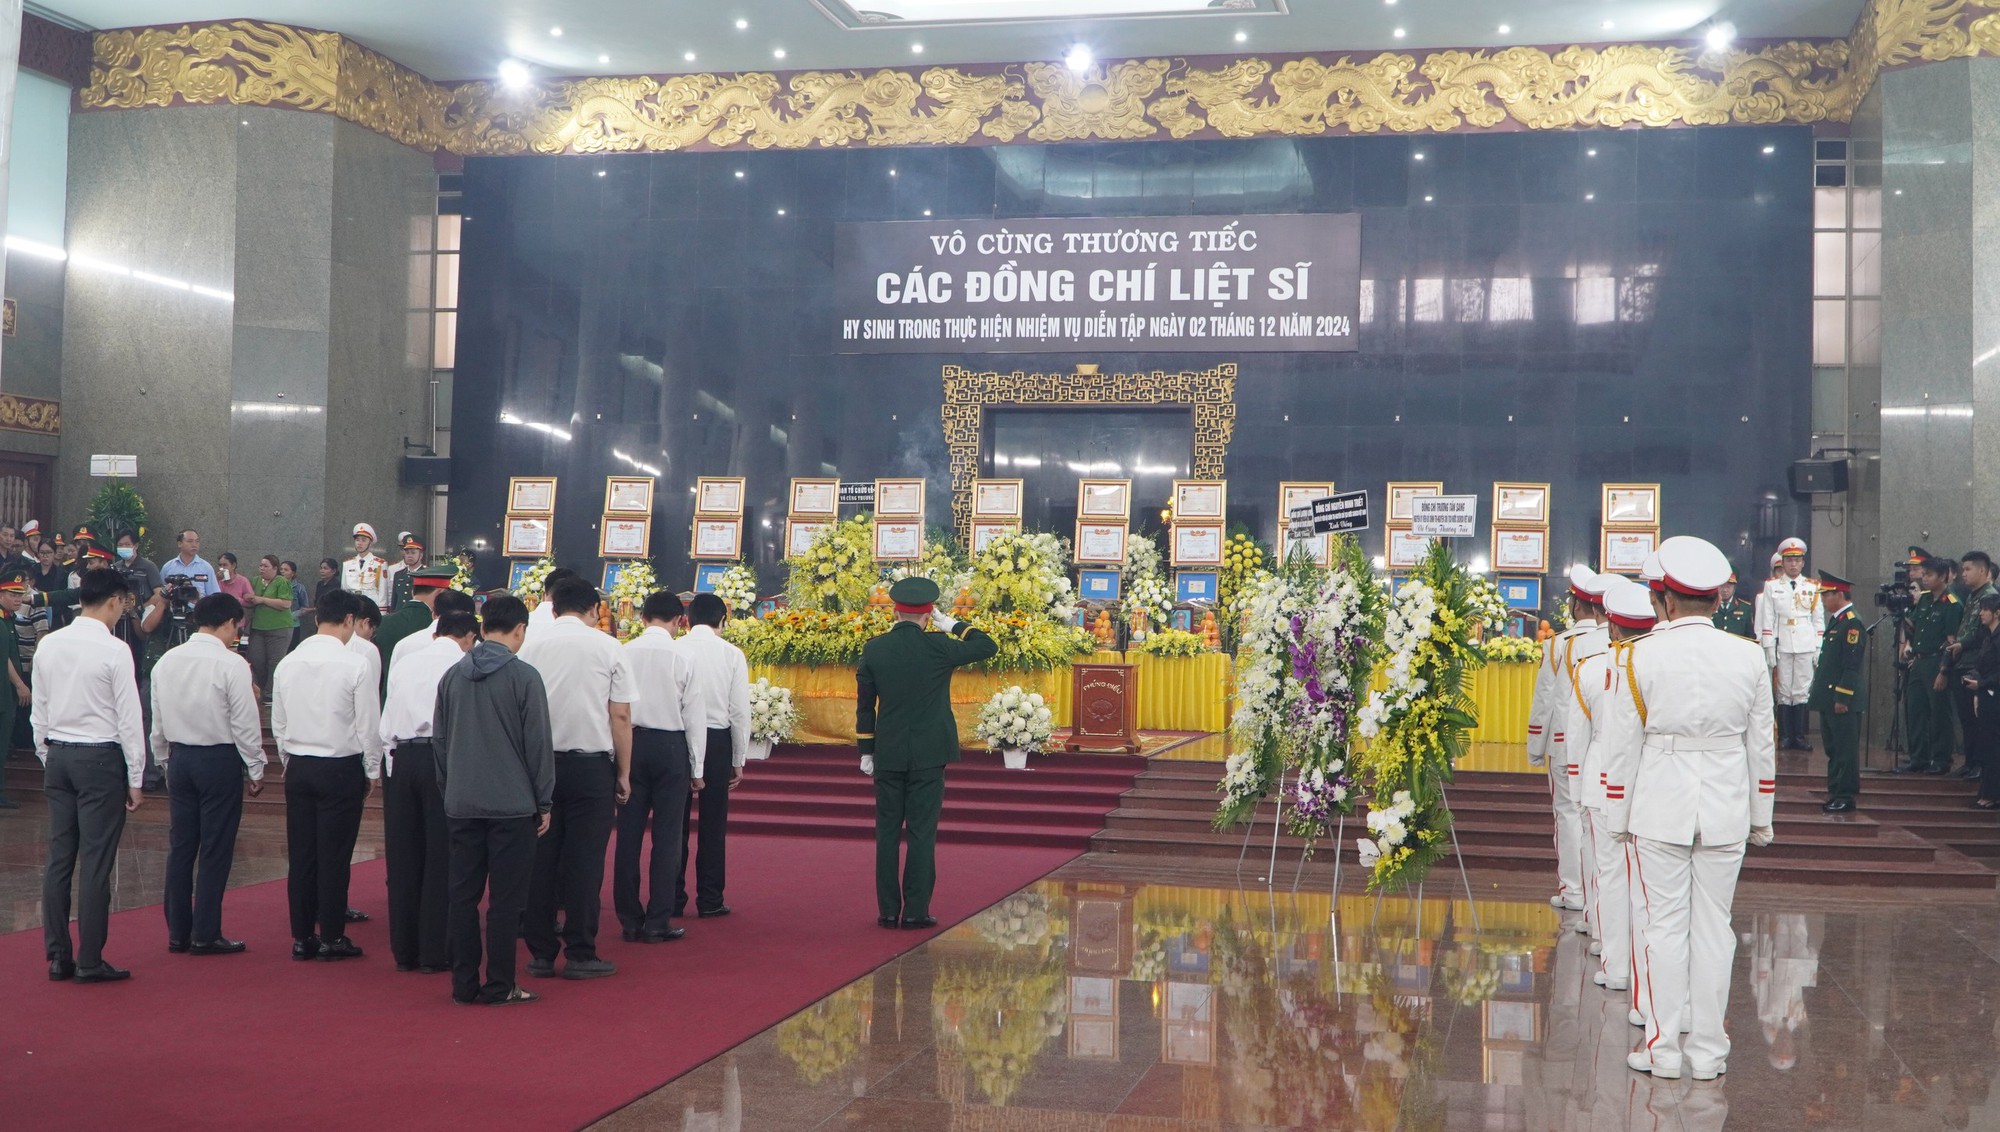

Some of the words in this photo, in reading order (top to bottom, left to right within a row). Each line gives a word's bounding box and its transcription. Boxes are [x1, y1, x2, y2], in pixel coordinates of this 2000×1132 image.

[930, 229, 966, 255] VÔ
[977, 228, 1053, 254] CÙNG
[1063, 229, 1179, 253] THƯƠNG
[1189, 221, 1257, 251] TIẾC
[877, 265, 952, 304] CÁC
[965, 260, 1075, 303] ĐỒNG
[1089, 262, 1158, 302] CHÍ
[1169, 261, 1255, 308] LIỆT
[1267, 261, 1313, 302] SĨ
[843, 319, 860, 340] HY
[864, 319, 895, 340] SINH
[899, 318, 941, 340] TRONG
[944, 315, 977, 343] THỰC
[981, 313, 1013, 343] HIỆN
[1016, 313, 1061, 342] NHIỆM
[1064, 316, 1082, 342] VỤ
[1084, 310, 1117, 338] DIỄN
[1120, 313, 1146, 342] TẬP
[1150, 312, 1186, 338] NGÀY
[1189, 316, 1207, 338] 02
[1210, 312, 1255, 338] THÁNG
[1259, 315, 1276, 337] 12
[1280, 312, 1313, 337] NĂM
[1316, 315, 1351, 337] 2024
